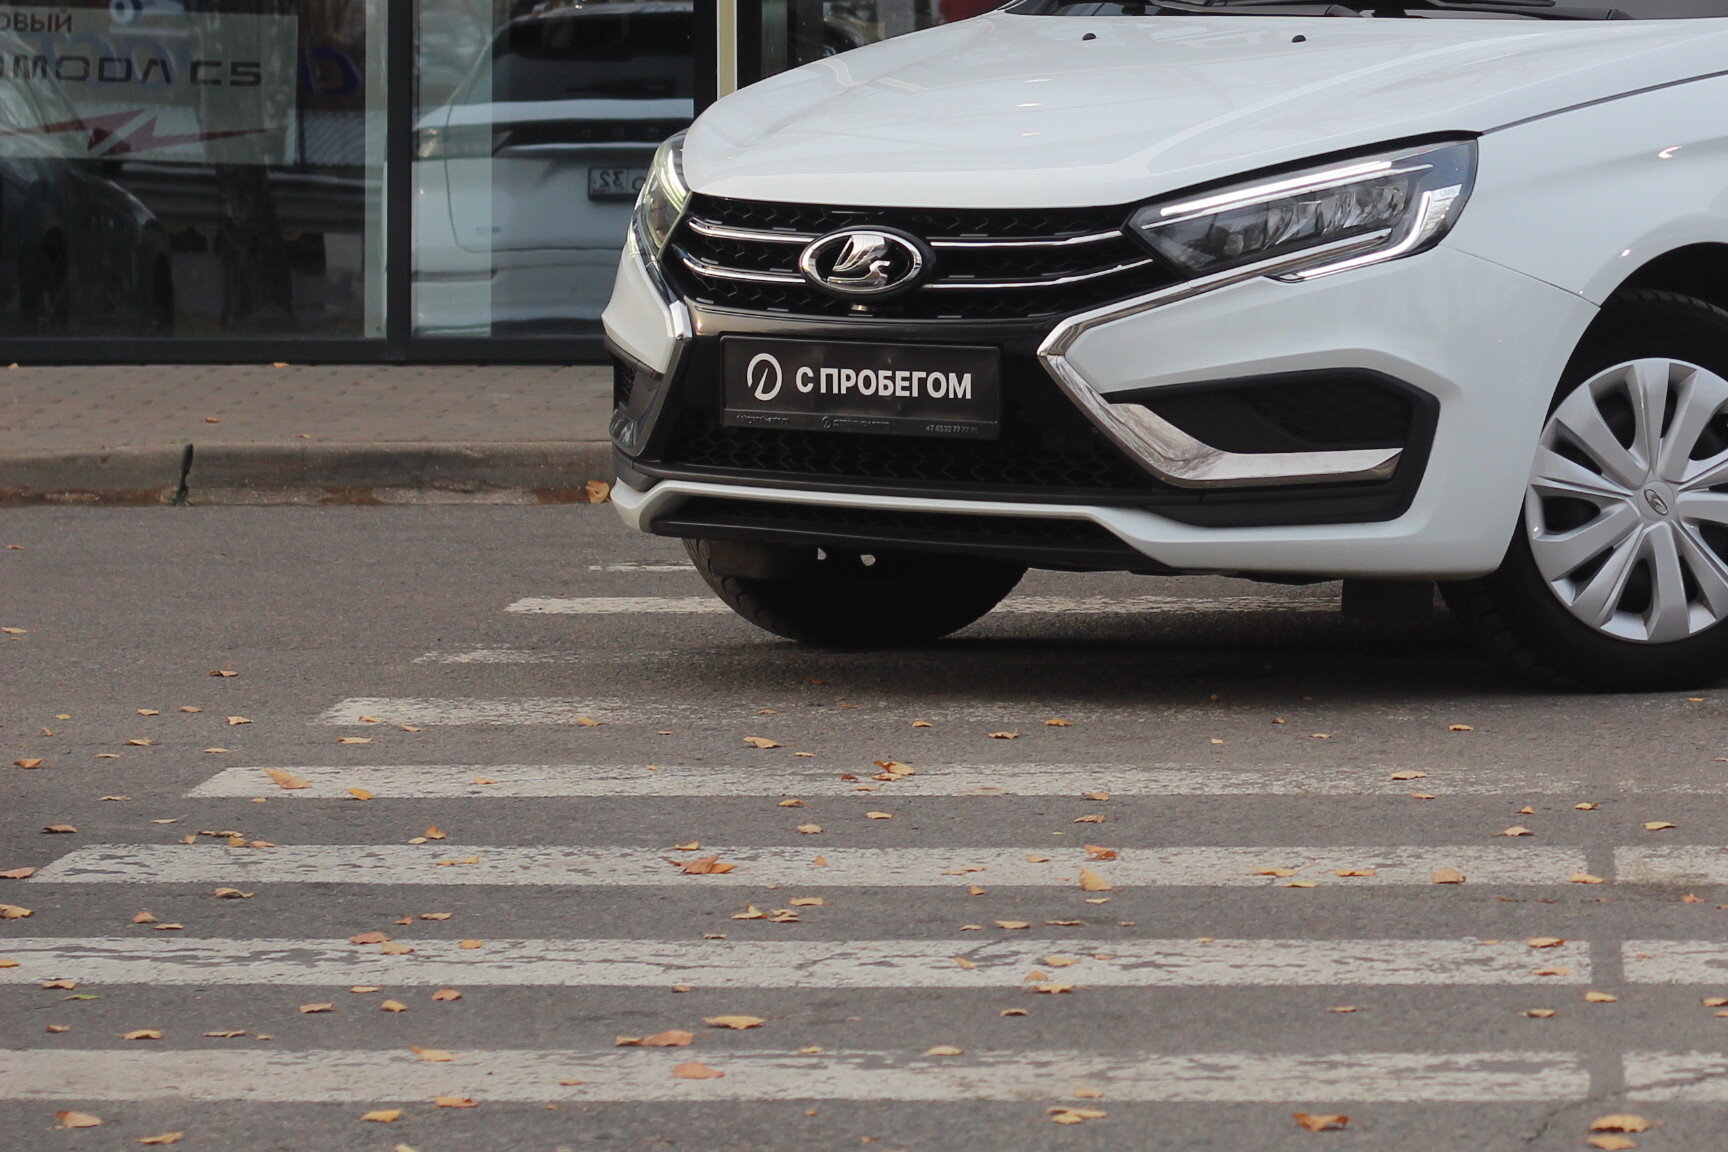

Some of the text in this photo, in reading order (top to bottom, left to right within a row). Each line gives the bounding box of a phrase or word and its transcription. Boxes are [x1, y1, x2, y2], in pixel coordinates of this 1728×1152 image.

[0, 54, 262, 87] MODA C5
[795, 366, 972, 399] С ПРОБЕГОМ
